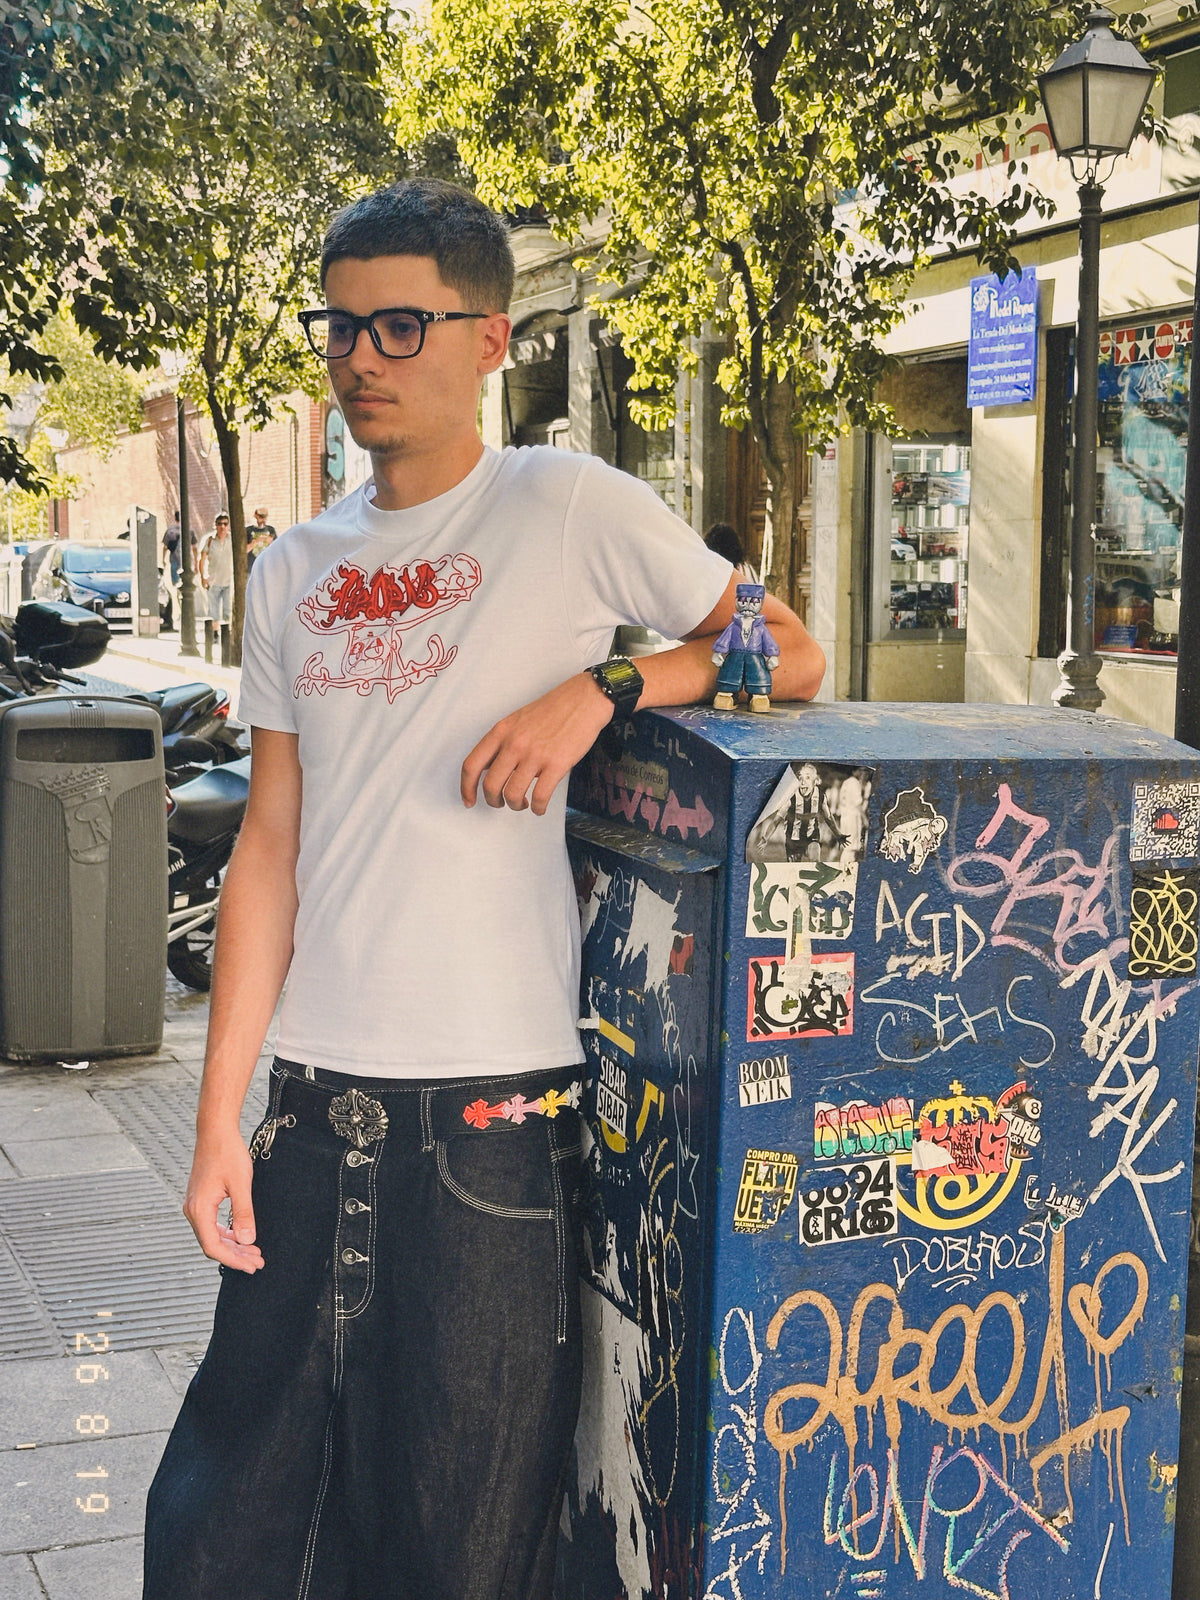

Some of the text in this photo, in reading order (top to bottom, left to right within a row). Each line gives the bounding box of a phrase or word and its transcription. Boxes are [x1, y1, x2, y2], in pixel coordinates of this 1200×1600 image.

[600, 1055, 627, 1099] SIBAR
[739, 1056, 790, 1085] BOOM
[598, 1086, 627, 1132] SIBAR
[746, 1149, 780, 1162] COMPRO
